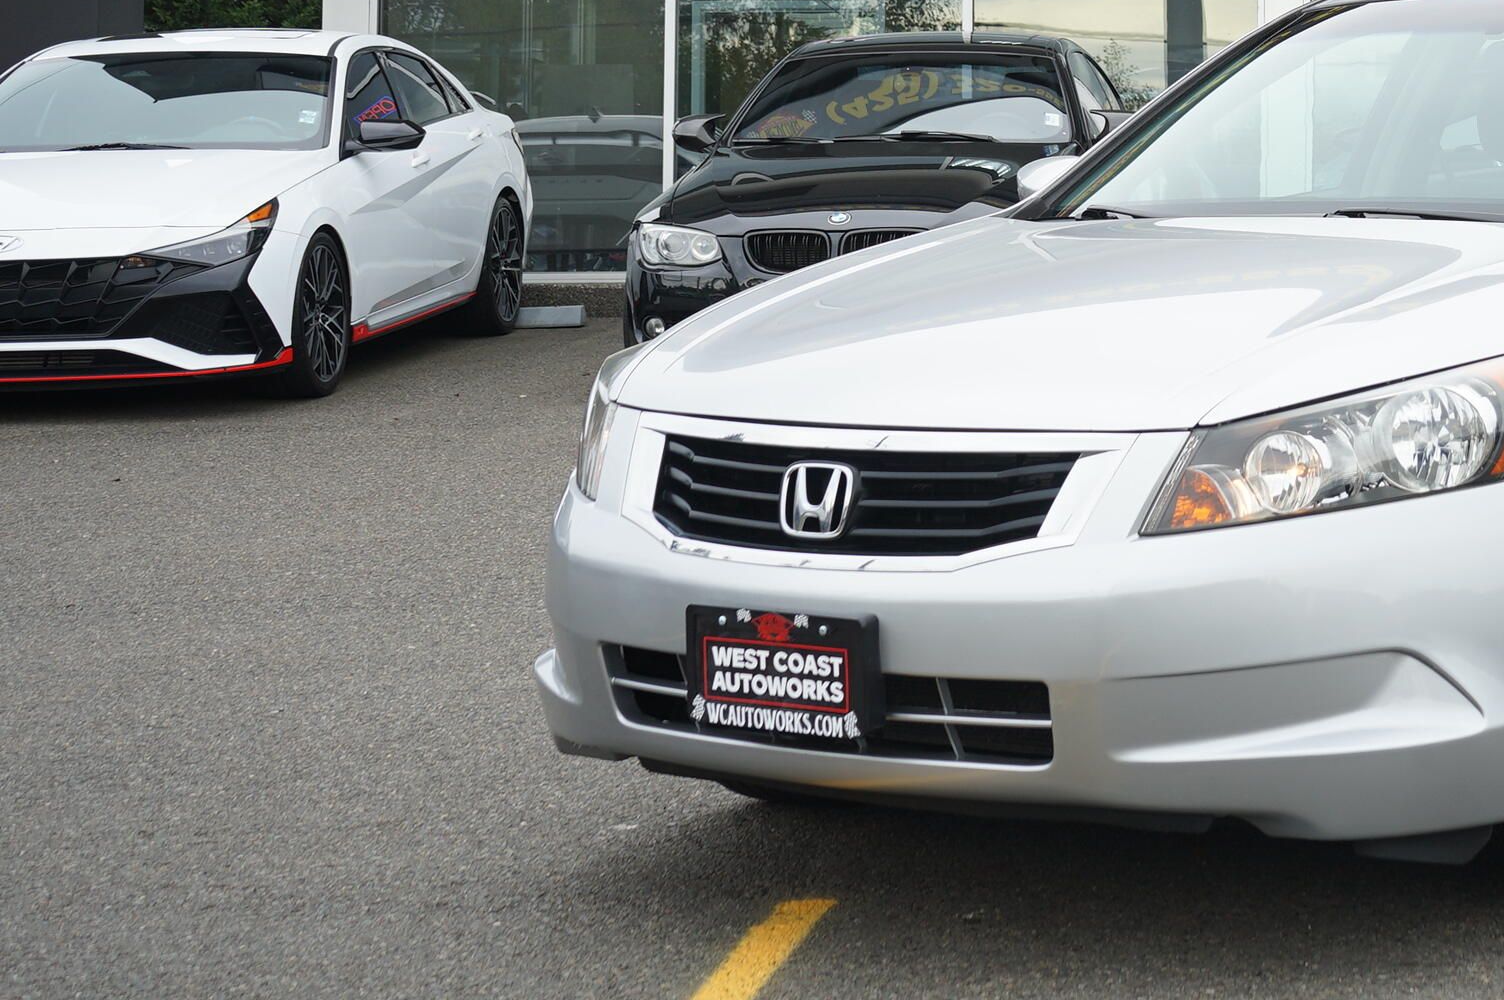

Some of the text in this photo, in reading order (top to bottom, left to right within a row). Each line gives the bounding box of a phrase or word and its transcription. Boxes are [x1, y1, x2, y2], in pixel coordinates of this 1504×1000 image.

[711, 646, 843, 678] WEST COAST
[711, 671, 845, 704] AUTOWORKS
[706, 702, 844, 738] WCAUTOWORKS.COM
